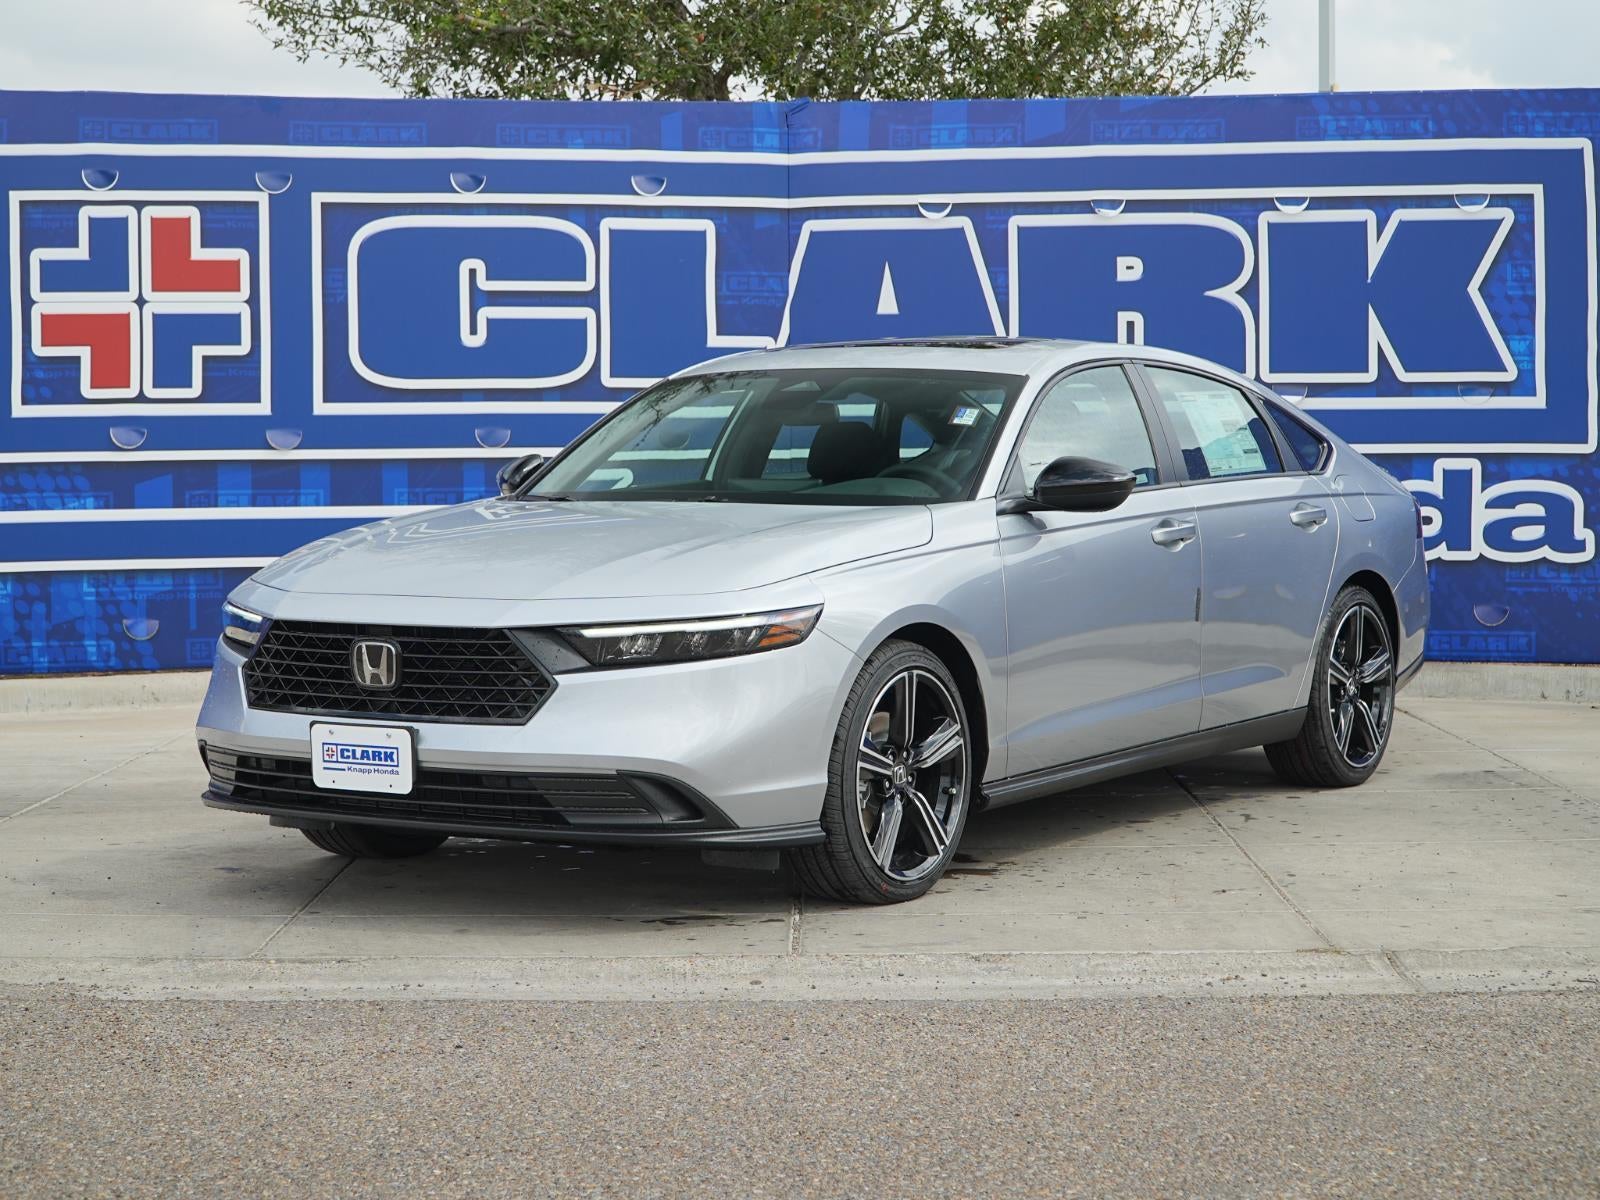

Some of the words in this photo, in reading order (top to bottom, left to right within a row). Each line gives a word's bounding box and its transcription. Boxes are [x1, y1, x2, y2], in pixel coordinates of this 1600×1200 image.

[346, 207, 1516, 390] CLARK
[340, 748, 396, 763] CLARK
[347, 766, 373, 775] Knapp
[373, 768, 400, 776] Honda
